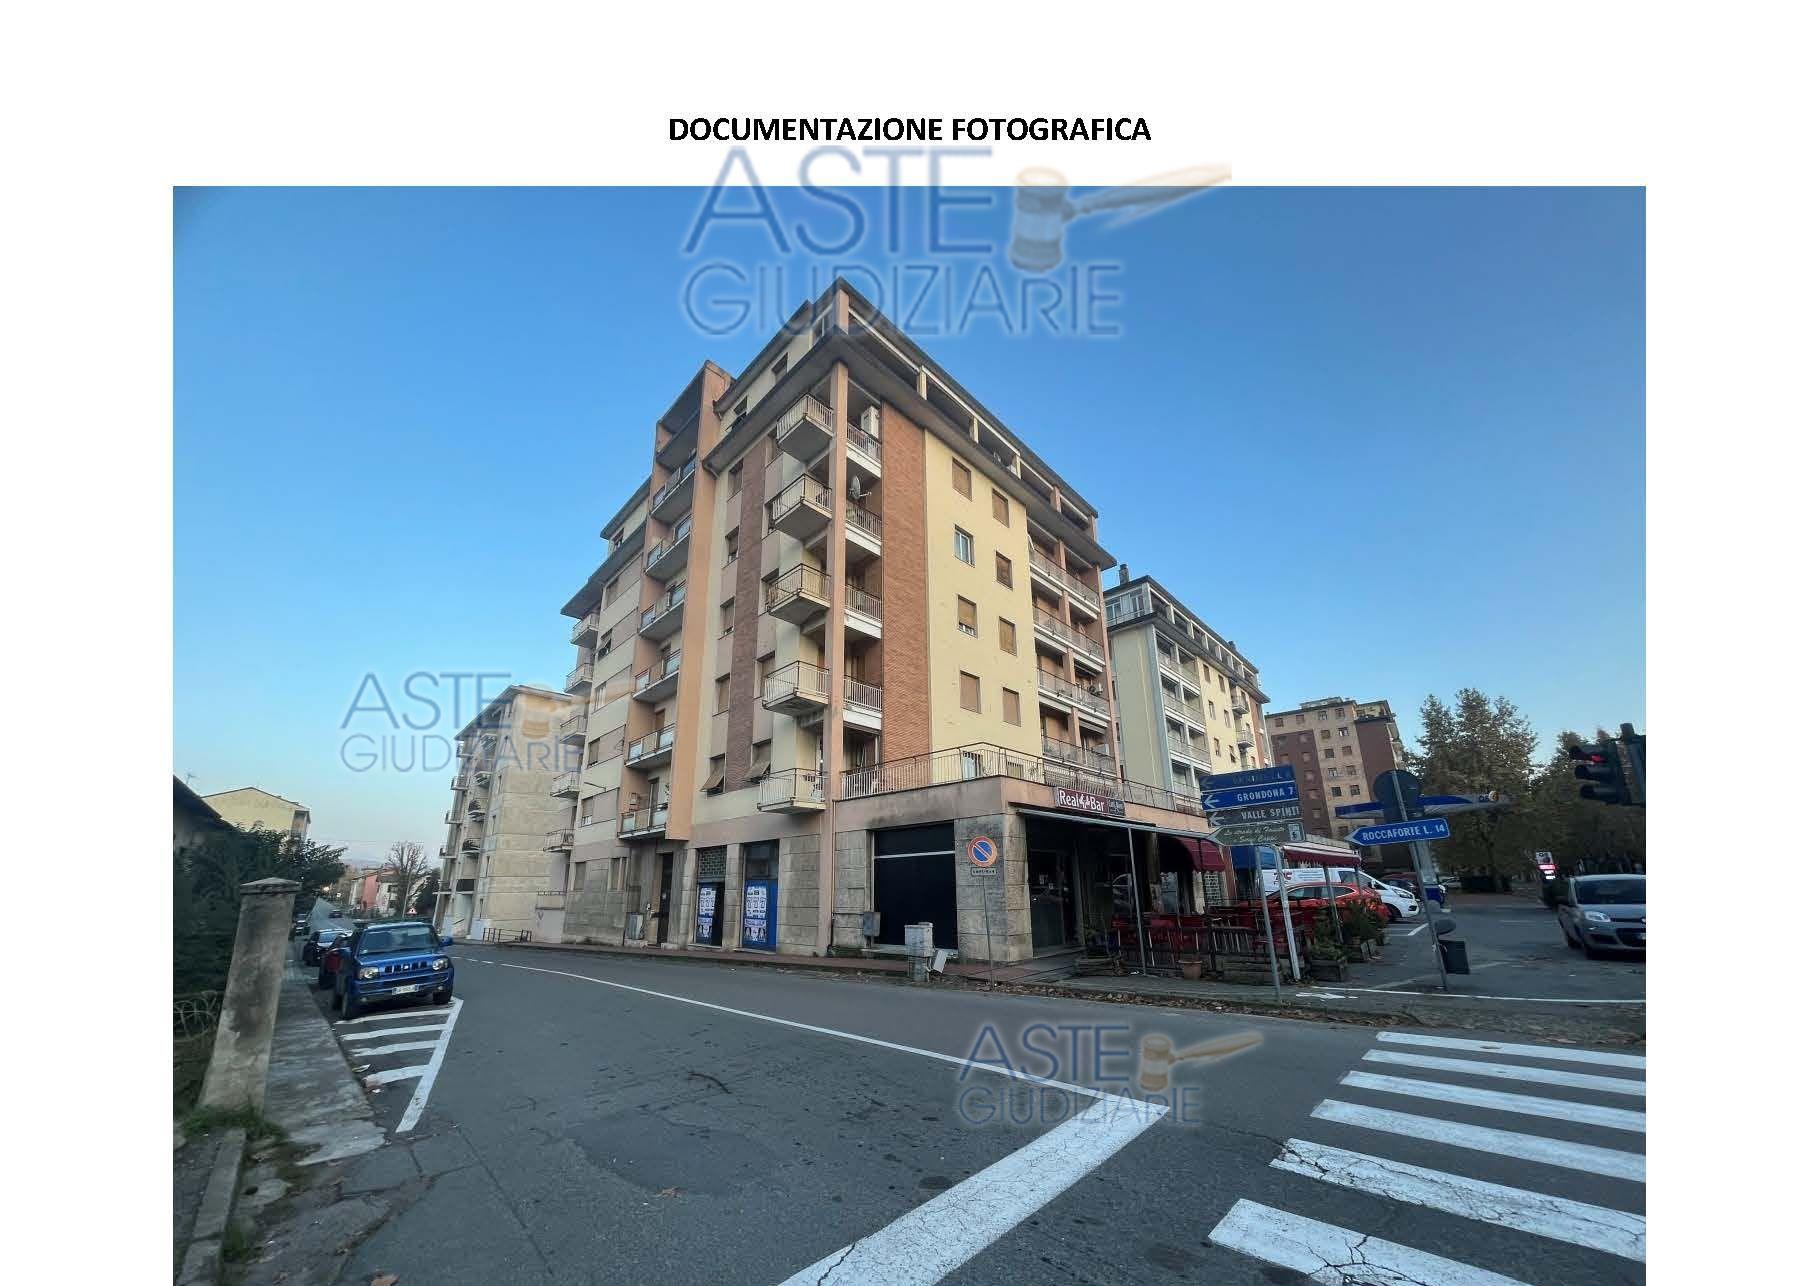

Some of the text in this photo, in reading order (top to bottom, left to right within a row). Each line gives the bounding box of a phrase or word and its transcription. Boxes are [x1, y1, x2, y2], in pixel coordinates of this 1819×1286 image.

[670, 118, 1151, 140] DOCUMENTAZIONE FOTOGRAFICA
[1059, 790, 1080, 808] Real
[1090, 796, 1105, 812] Bar
[1237, 786, 1294, 802] GRONDONA 7
[1241, 809, 1267, 820] VALLE
[1362, 823, 1446, 841] ROCCAFORTE L. 14
